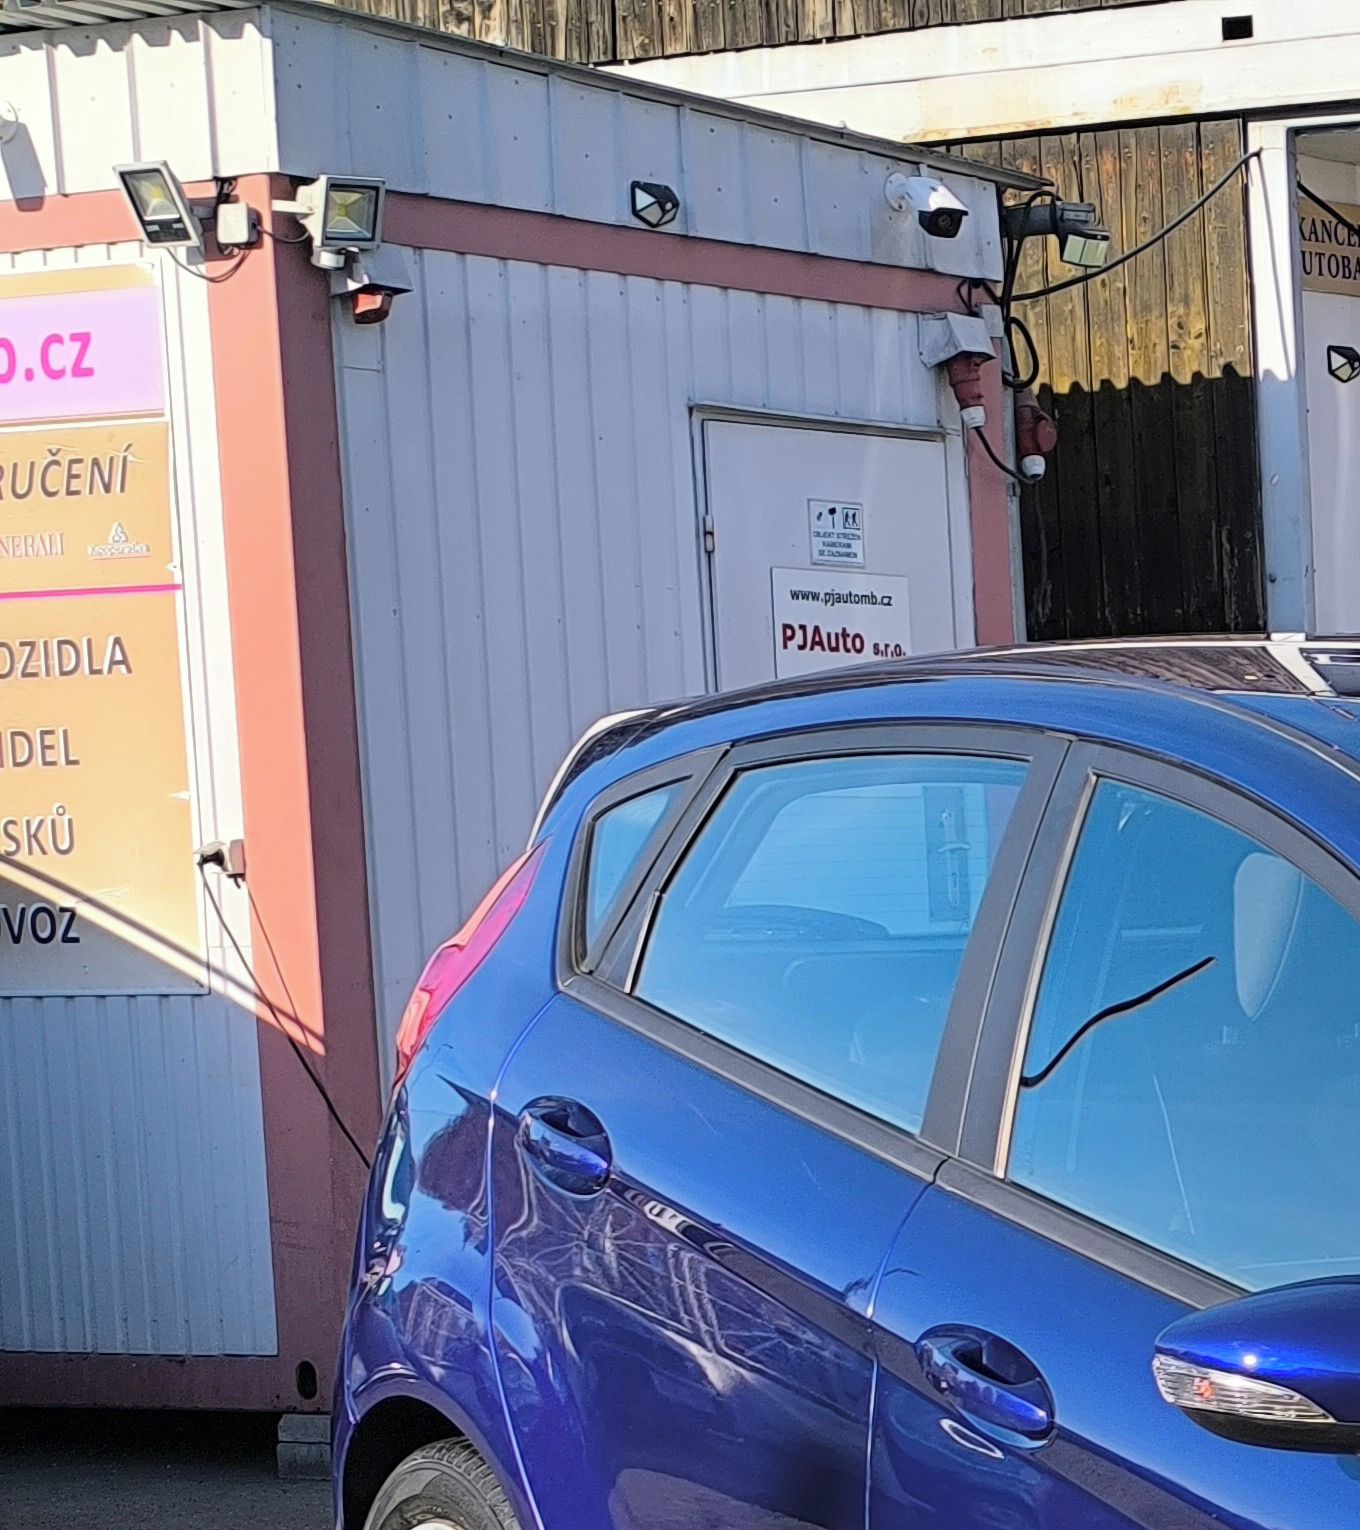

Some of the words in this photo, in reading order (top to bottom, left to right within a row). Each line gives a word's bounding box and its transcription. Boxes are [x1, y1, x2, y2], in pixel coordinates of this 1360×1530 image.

[0, 443, 133, 500] UČENÍ
[790, 588, 893, 607] www.pjautomb.cz
[782, 623, 865, 655] PJAuto
[873, 642, 906, 658] s.r.o.
